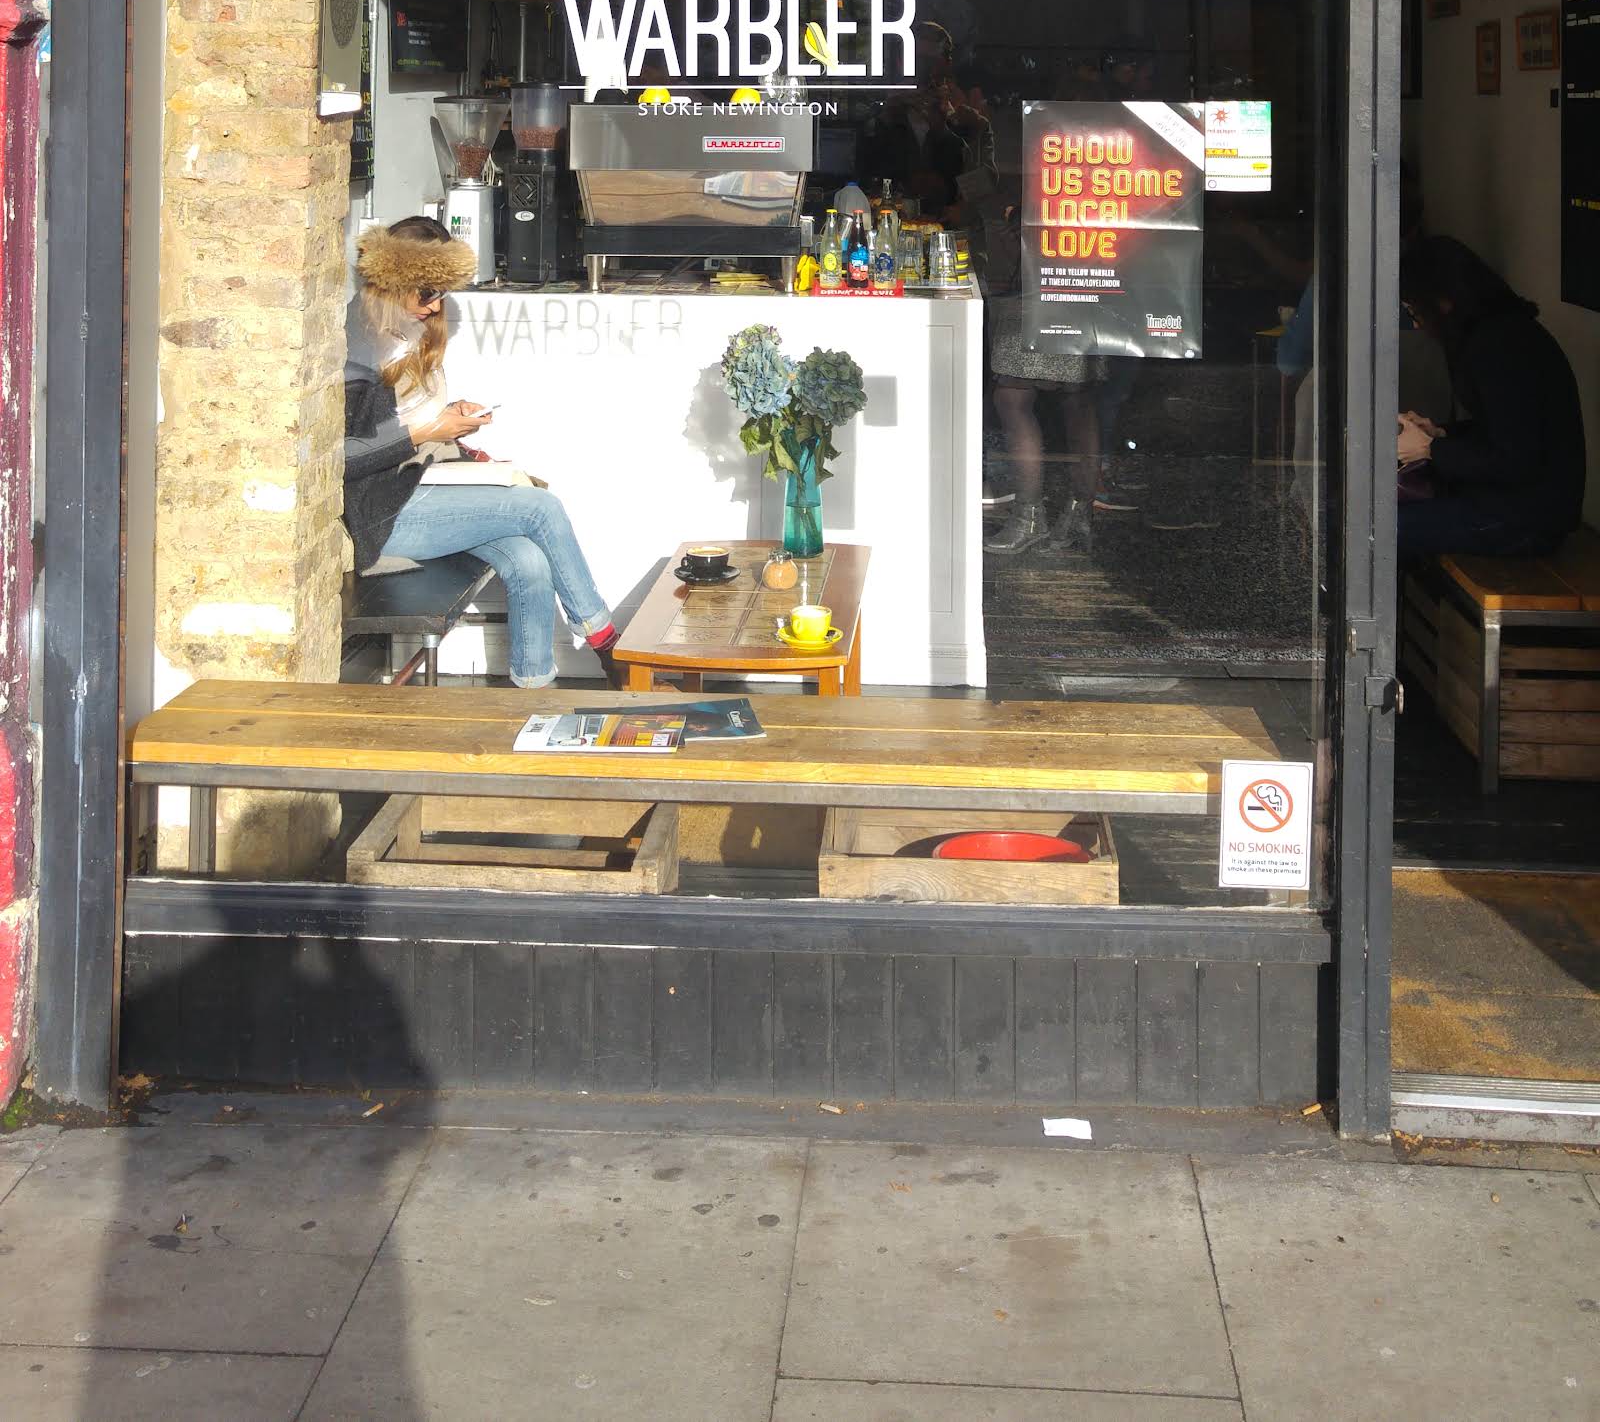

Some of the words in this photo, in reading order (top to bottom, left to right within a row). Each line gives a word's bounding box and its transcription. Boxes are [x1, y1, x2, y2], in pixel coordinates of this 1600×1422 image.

[638, 101, 703, 116] STOKE
[713, 101, 838, 116] NEWINGTON
[1041, 134, 1134, 165] SHOW
[1042, 166, 1083, 196] US
[1092, 168, 1183, 197] SOME
[1041, 199, 1135, 228] LOCAL
[1041, 230, 1117, 259] LOVE
[1040, 267, 1054, 276] VOTE
[1055, 268, 1066, 276] FOR
[1068, 268, 1088, 277] YELLOW
[1090, 269, 1115, 277] WARBLER
[1040, 278, 1047, 286] AT
[1048, 278, 1120, 288] TIMEOUT.COM/LOVELONDON
[1040, 293, 1099, 303] #LOVELONDONAWARDS
[1228, 841, 1245, 853] NO
[1247, 842, 1304, 855] SMOKING.
[1243, 859, 1267, 867] against
